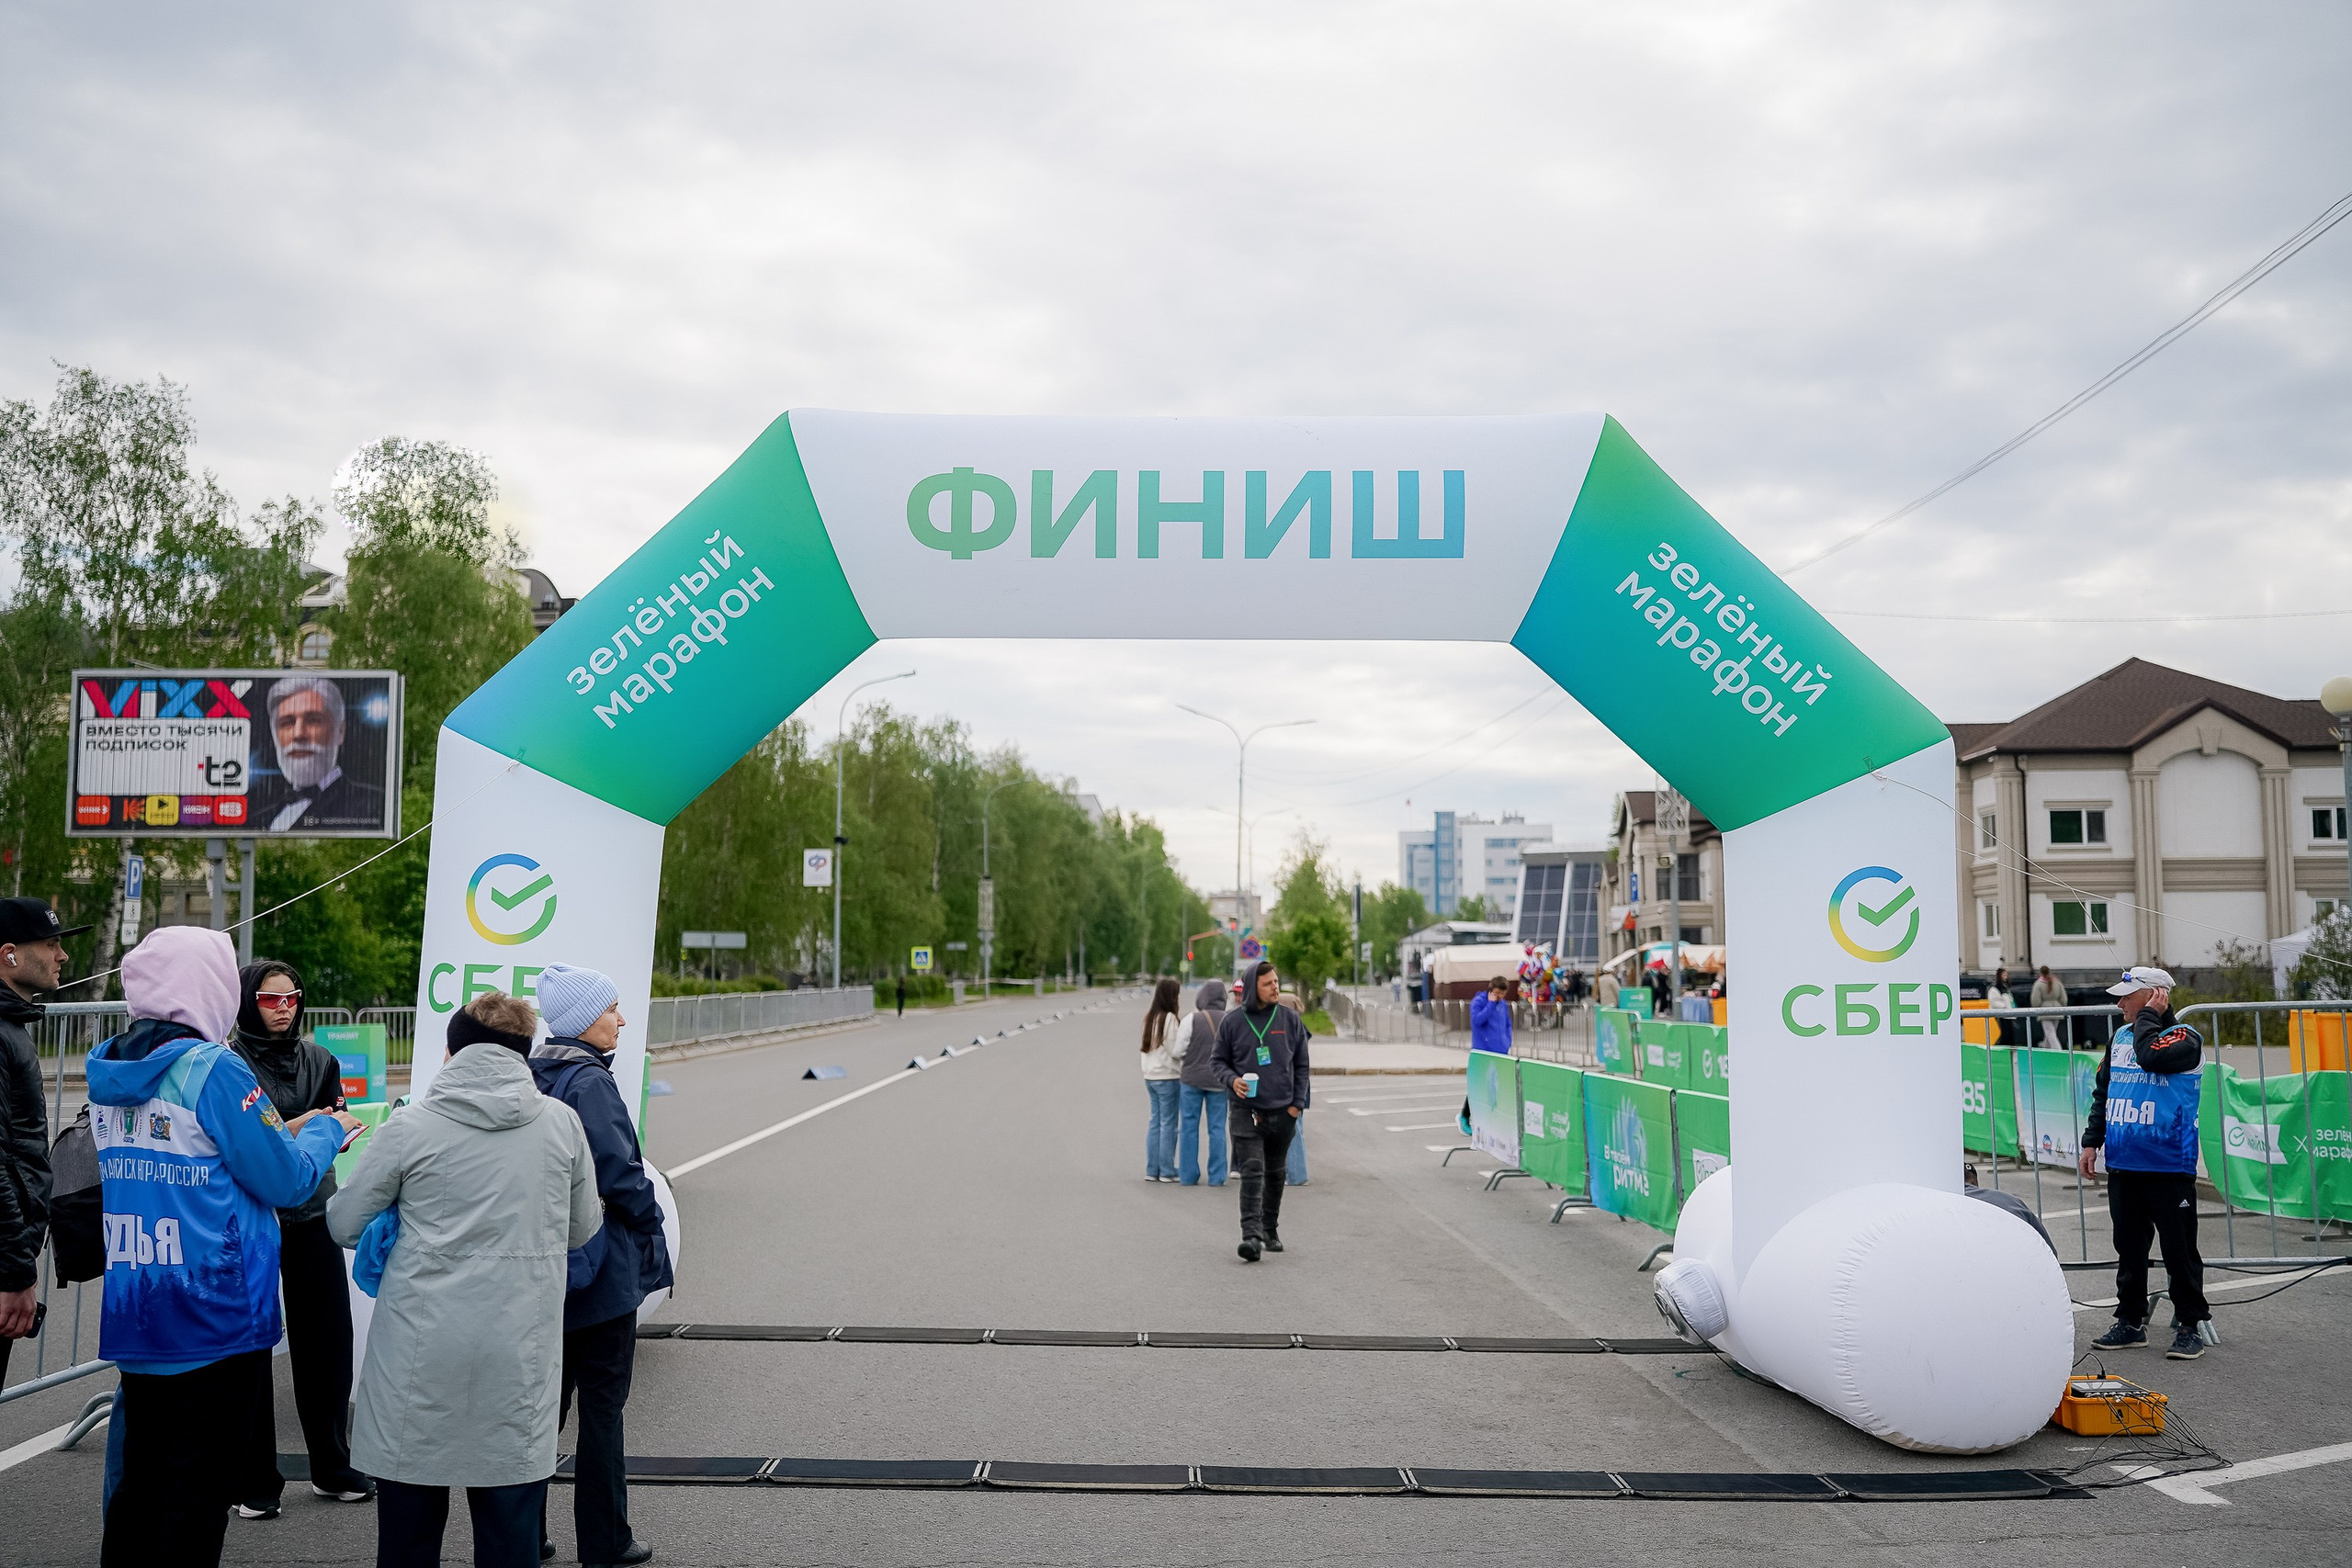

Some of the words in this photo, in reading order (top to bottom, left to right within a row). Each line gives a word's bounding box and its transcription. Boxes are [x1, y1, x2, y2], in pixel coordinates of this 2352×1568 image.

[905, 467, 1465, 560] ФИНИШ
[566, 528, 745, 695] зелёный
[1647, 541, 1833, 706] зелёный
[592, 566, 775, 730] марафон
[1614, 570, 1799, 738] марафон
[85, 725, 161, 736] ВМЕСТО
[167, 726, 243, 737] ТЫСЯЧИ
[85, 739, 188, 751] ПОДПИСОК
[205, 756, 242, 787] t2
[130, 861, 141, 896] P
[428, 962, 547, 1018] СБЕ
[1781, 983, 1953, 1038] СБЕР
